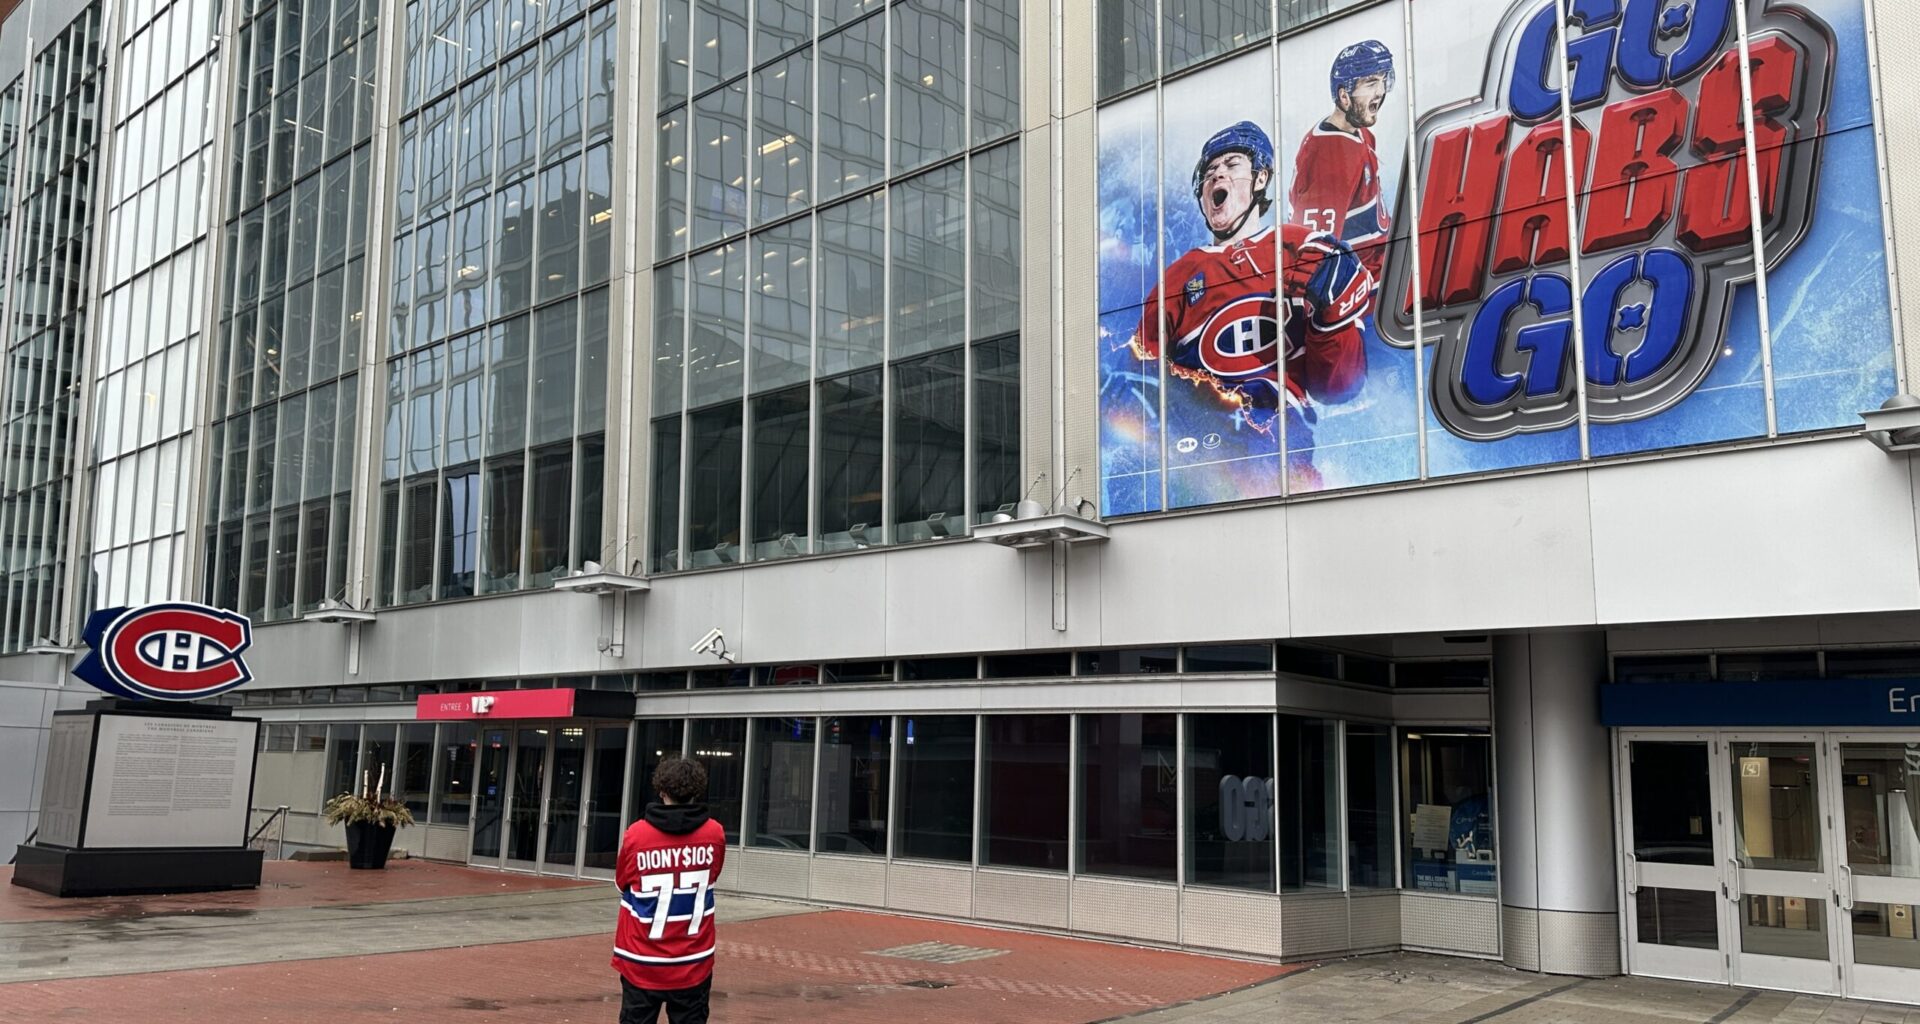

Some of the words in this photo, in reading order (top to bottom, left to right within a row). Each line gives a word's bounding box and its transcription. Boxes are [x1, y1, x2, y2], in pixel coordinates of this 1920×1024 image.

[1511, 0, 1734, 119] GO
[1303, 208, 1336, 234] 53
[1404, 36, 1798, 315] HABS
[1462, 247, 1696, 406] GO
[637, 844, 714, 871] DIONY$IO$
[641, 869, 710, 940] 77
